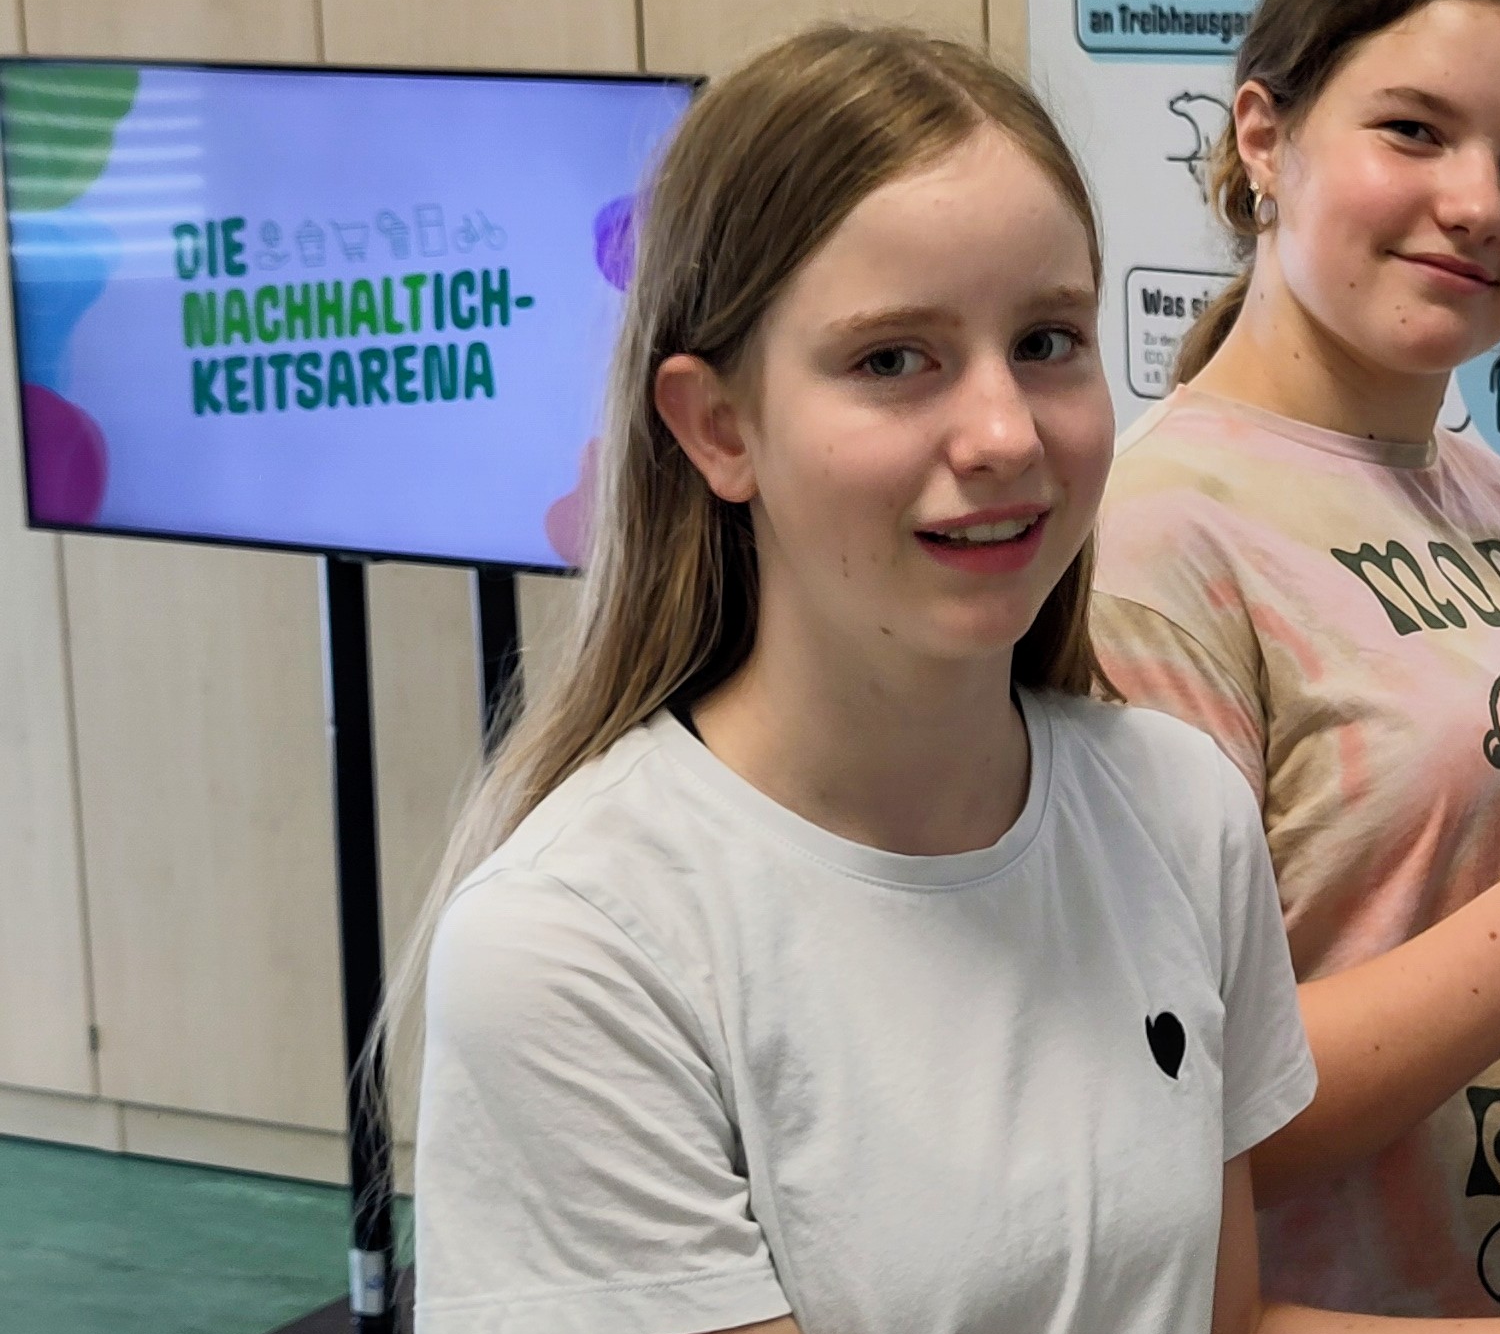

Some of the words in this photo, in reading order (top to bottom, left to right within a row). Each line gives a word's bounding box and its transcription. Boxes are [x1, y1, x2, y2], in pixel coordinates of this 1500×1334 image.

[1090, 10, 1114, 34] an
[171, 216, 248, 280] DIE
[181, 267, 536, 349] NACHHALTICH-
[1142, 287, 1185, 318] Was
[191, 341, 497, 417] KEITSARENA
